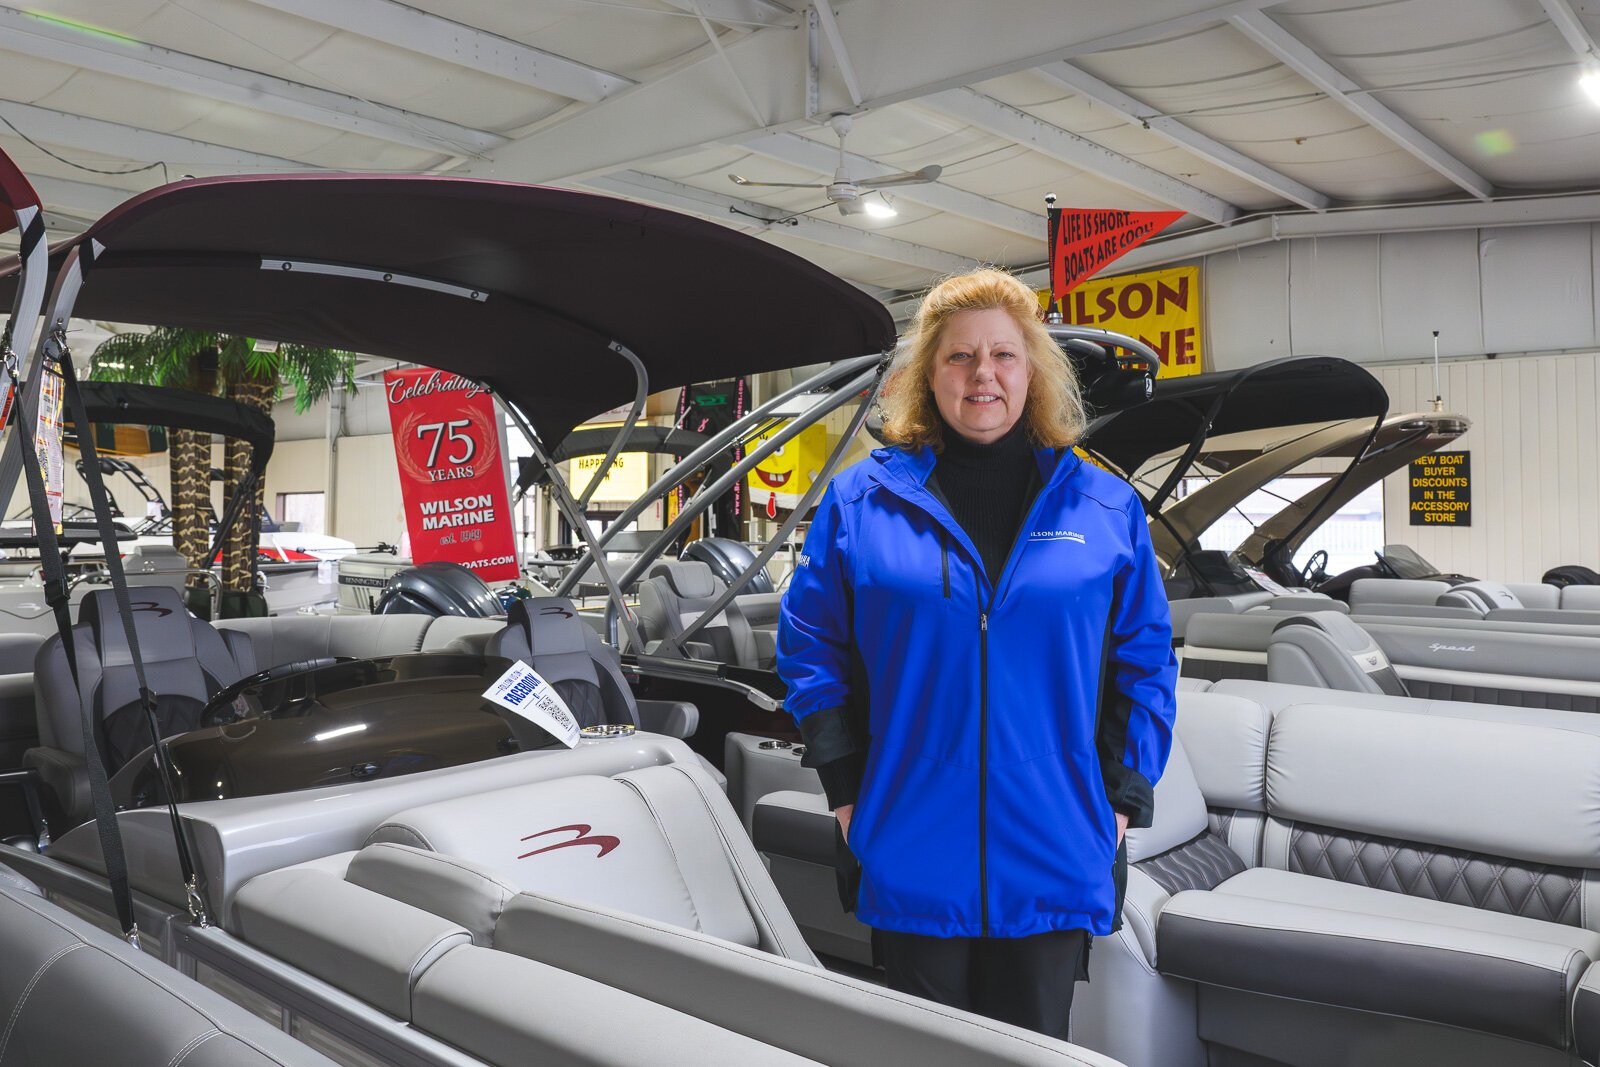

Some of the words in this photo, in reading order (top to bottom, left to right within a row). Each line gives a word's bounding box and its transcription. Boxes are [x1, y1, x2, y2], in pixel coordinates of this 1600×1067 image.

[1062, 213, 1081, 246] LIFE
[1083, 213, 1092, 239] IS
[1093, 211, 1139, 235] SHORT...
[1064, 245, 1094, 287] BOATS
[1096, 235, 1117, 264] ARE
[1119, 221, 1153, 249] COOL!
[1047, 276, 1189, 326] ILSON
[386, 370, 485, 404] Celebrating
[417, 419, 476, 468] 75
[1413, 455, 1437, 465] NEW
[1440, 455, 1464, 465] BOAT
[428, 465, 475, 483] YEARS
[1424, 466, 1456, 476] BUYER
[1412, 477, 1468, 487] DISCOUNTS
[1423, 490, 1434, 500] IN
[1436, 490, 1456, 500] THE
[420, 494, 493, 516] WILSON
[1411, 501, 1469, 511] ACCESSORY
[422, 509, 495, 531] MARINE
[1424, 512, 1456, 522] STORE
[1055, 531, 1084, 539] MARINE
[457, 556, 514, 569] OATS.COM
[503, 672, 542, 706] FACEBOOK
